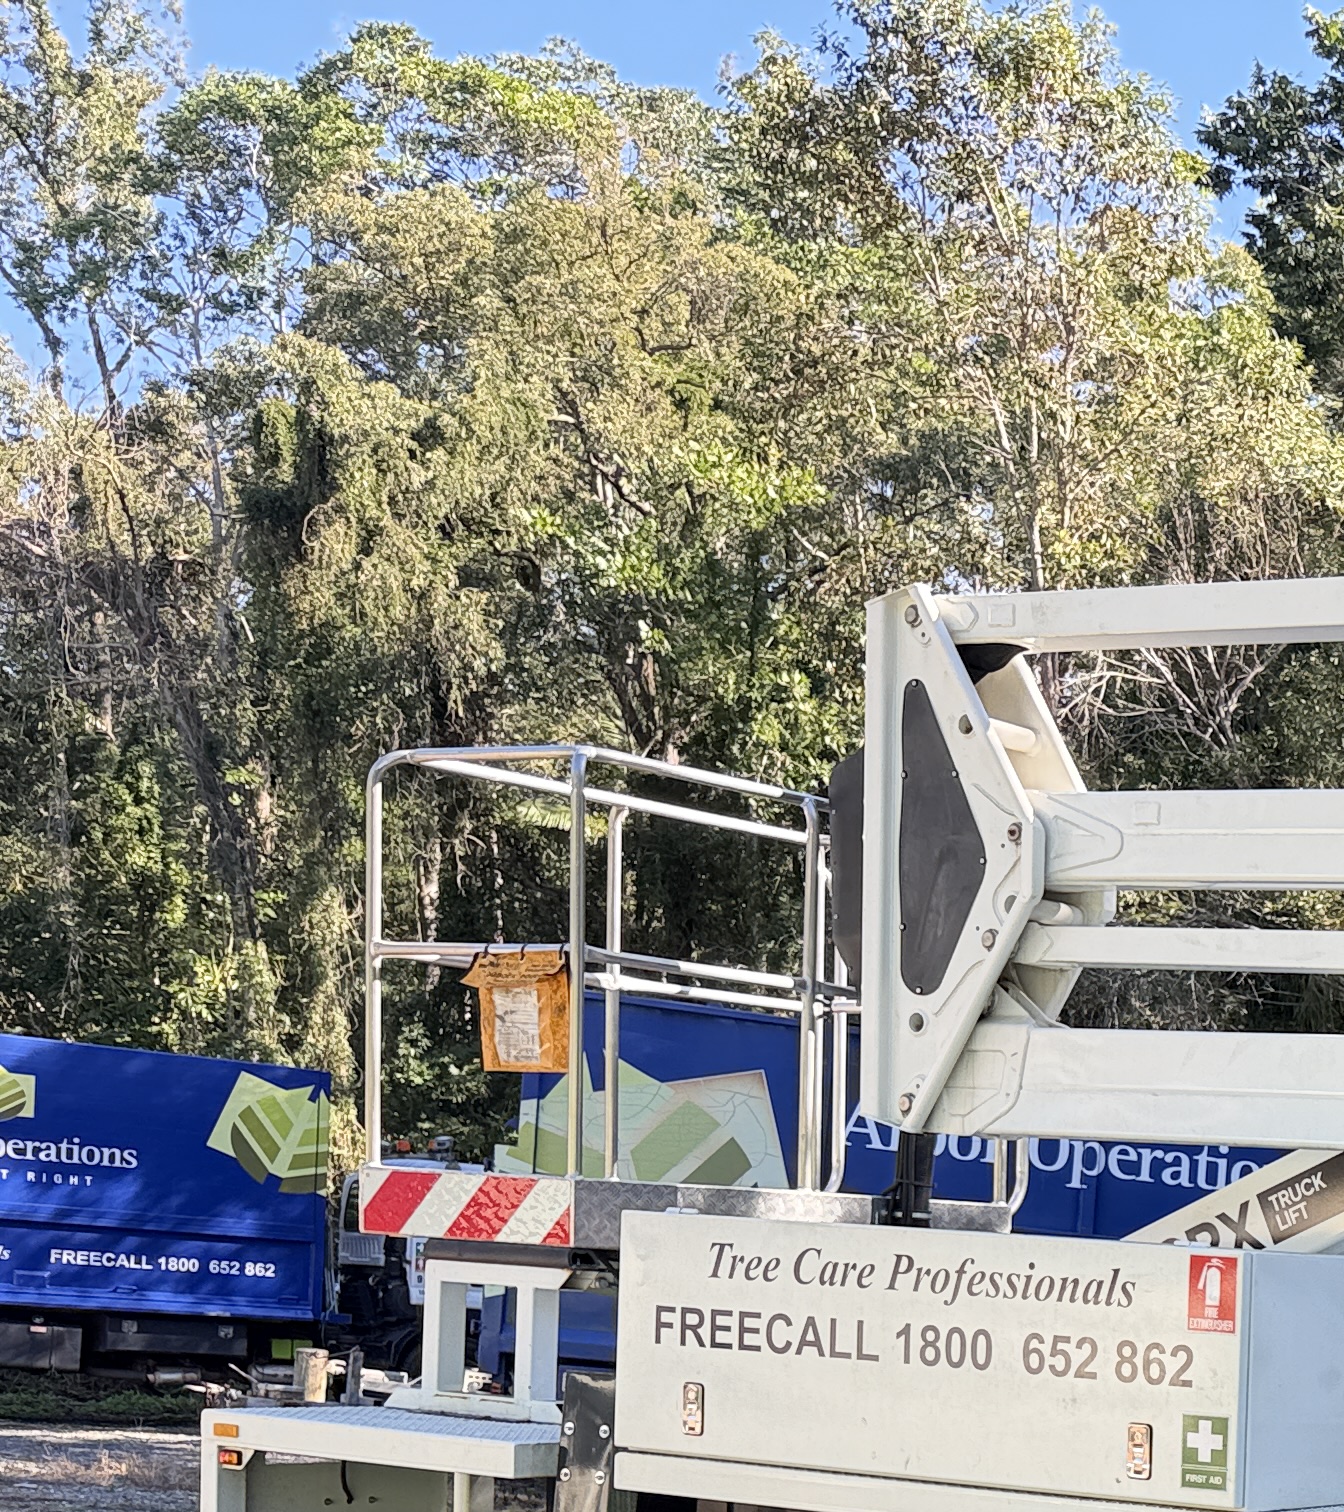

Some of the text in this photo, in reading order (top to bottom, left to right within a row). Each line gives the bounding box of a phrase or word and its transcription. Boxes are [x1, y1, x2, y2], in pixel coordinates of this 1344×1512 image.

[0, 1137, 139, 1169] erations
[1028, 1137, 1266, 1190] Operatio
[26, 1170, 94, 1187] RIGHT
[1268, 1171, 1328, 1212] TRUCK
[1162, 1199, 1267, 1249] PX
[1275, 1201, 1309, 1232] LIFT
[50, 1248, 276, 1278] FREECALL 1800 652 862
[708, 1242, 1137, 1308] Tree Care Professionals
[654, 1304, 1194, 1388] FREECALL 1800 652 862
[1185, 1473, 1223, 1485] FIRST AID
